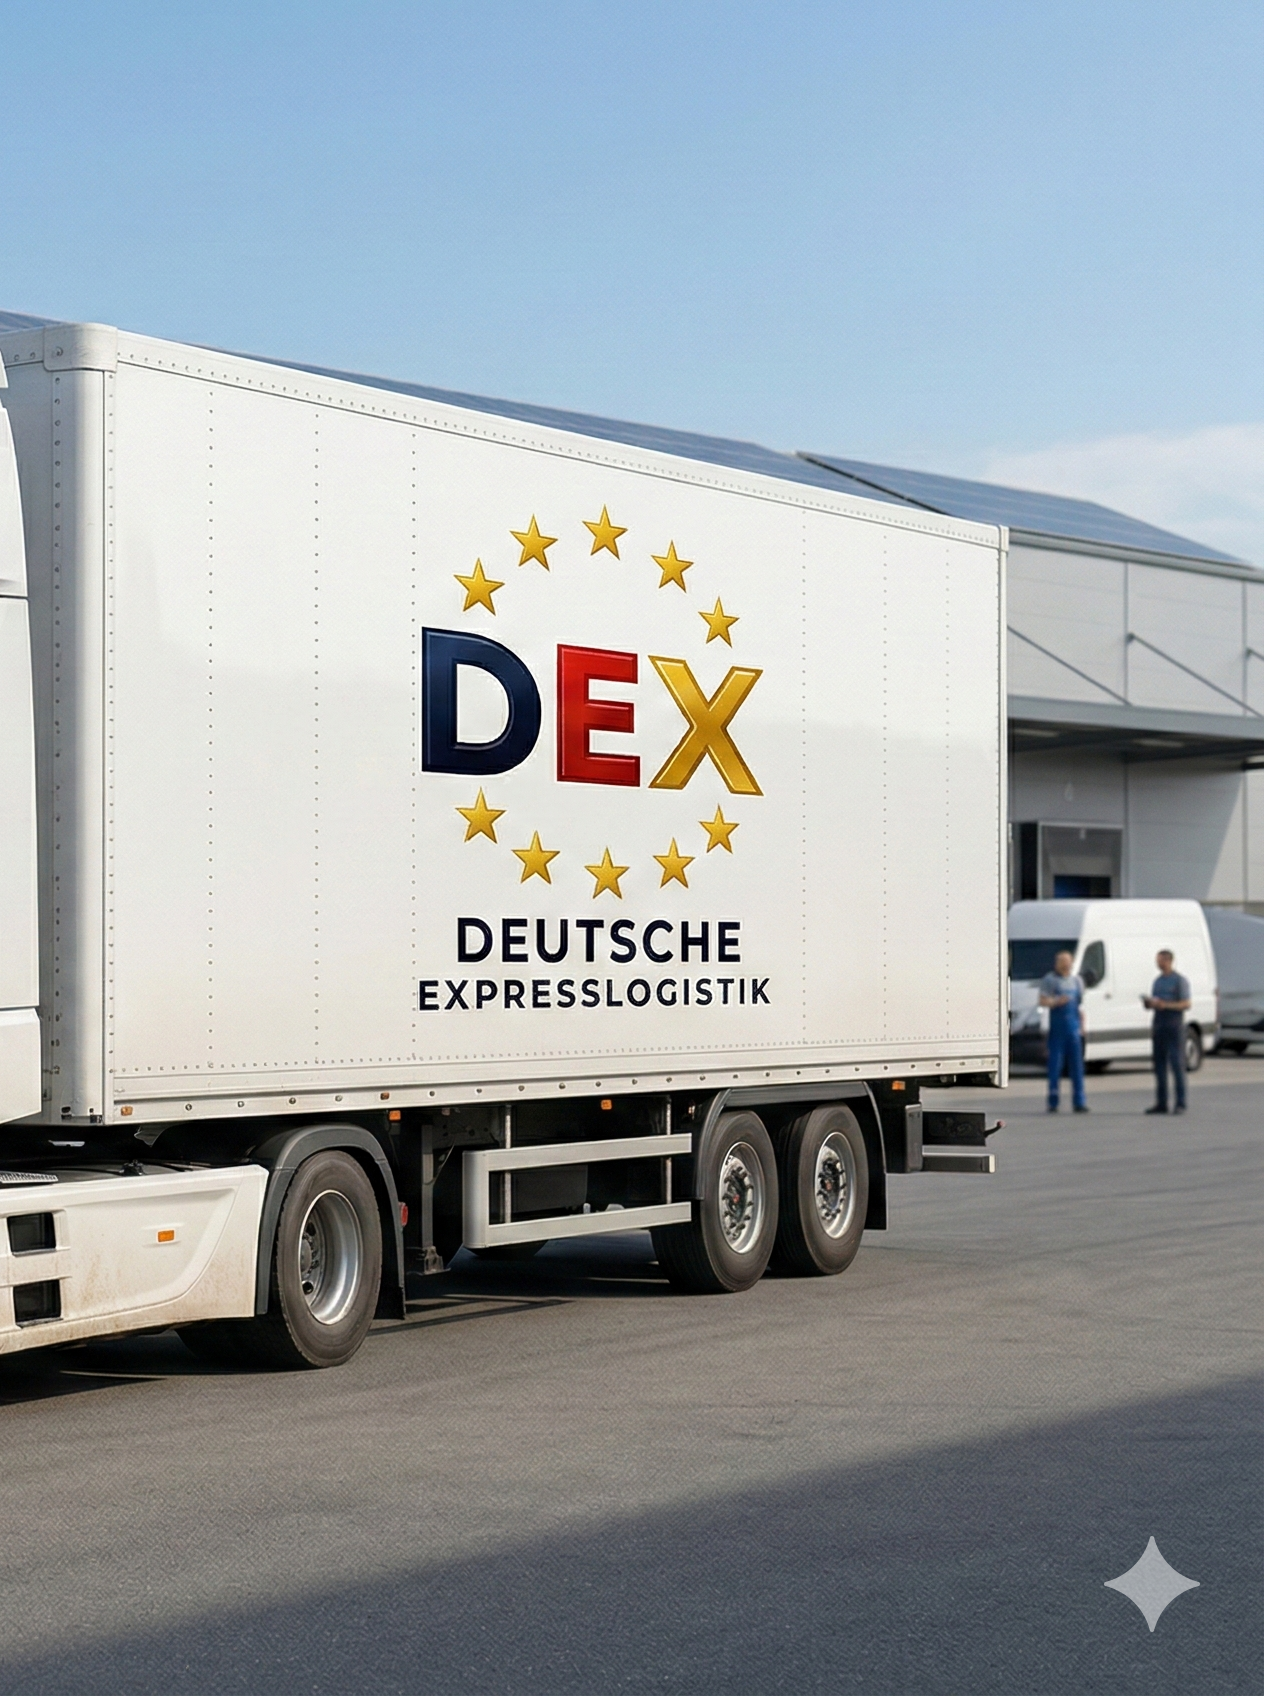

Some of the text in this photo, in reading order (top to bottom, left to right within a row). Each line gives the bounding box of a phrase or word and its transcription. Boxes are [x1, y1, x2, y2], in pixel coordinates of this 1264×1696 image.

[421, 626, 764, 797] DEX
[456, 917, 742, 964] DEUTSCHE
[418, 977, 771, 1012] EXPRESSLOGISTIK
